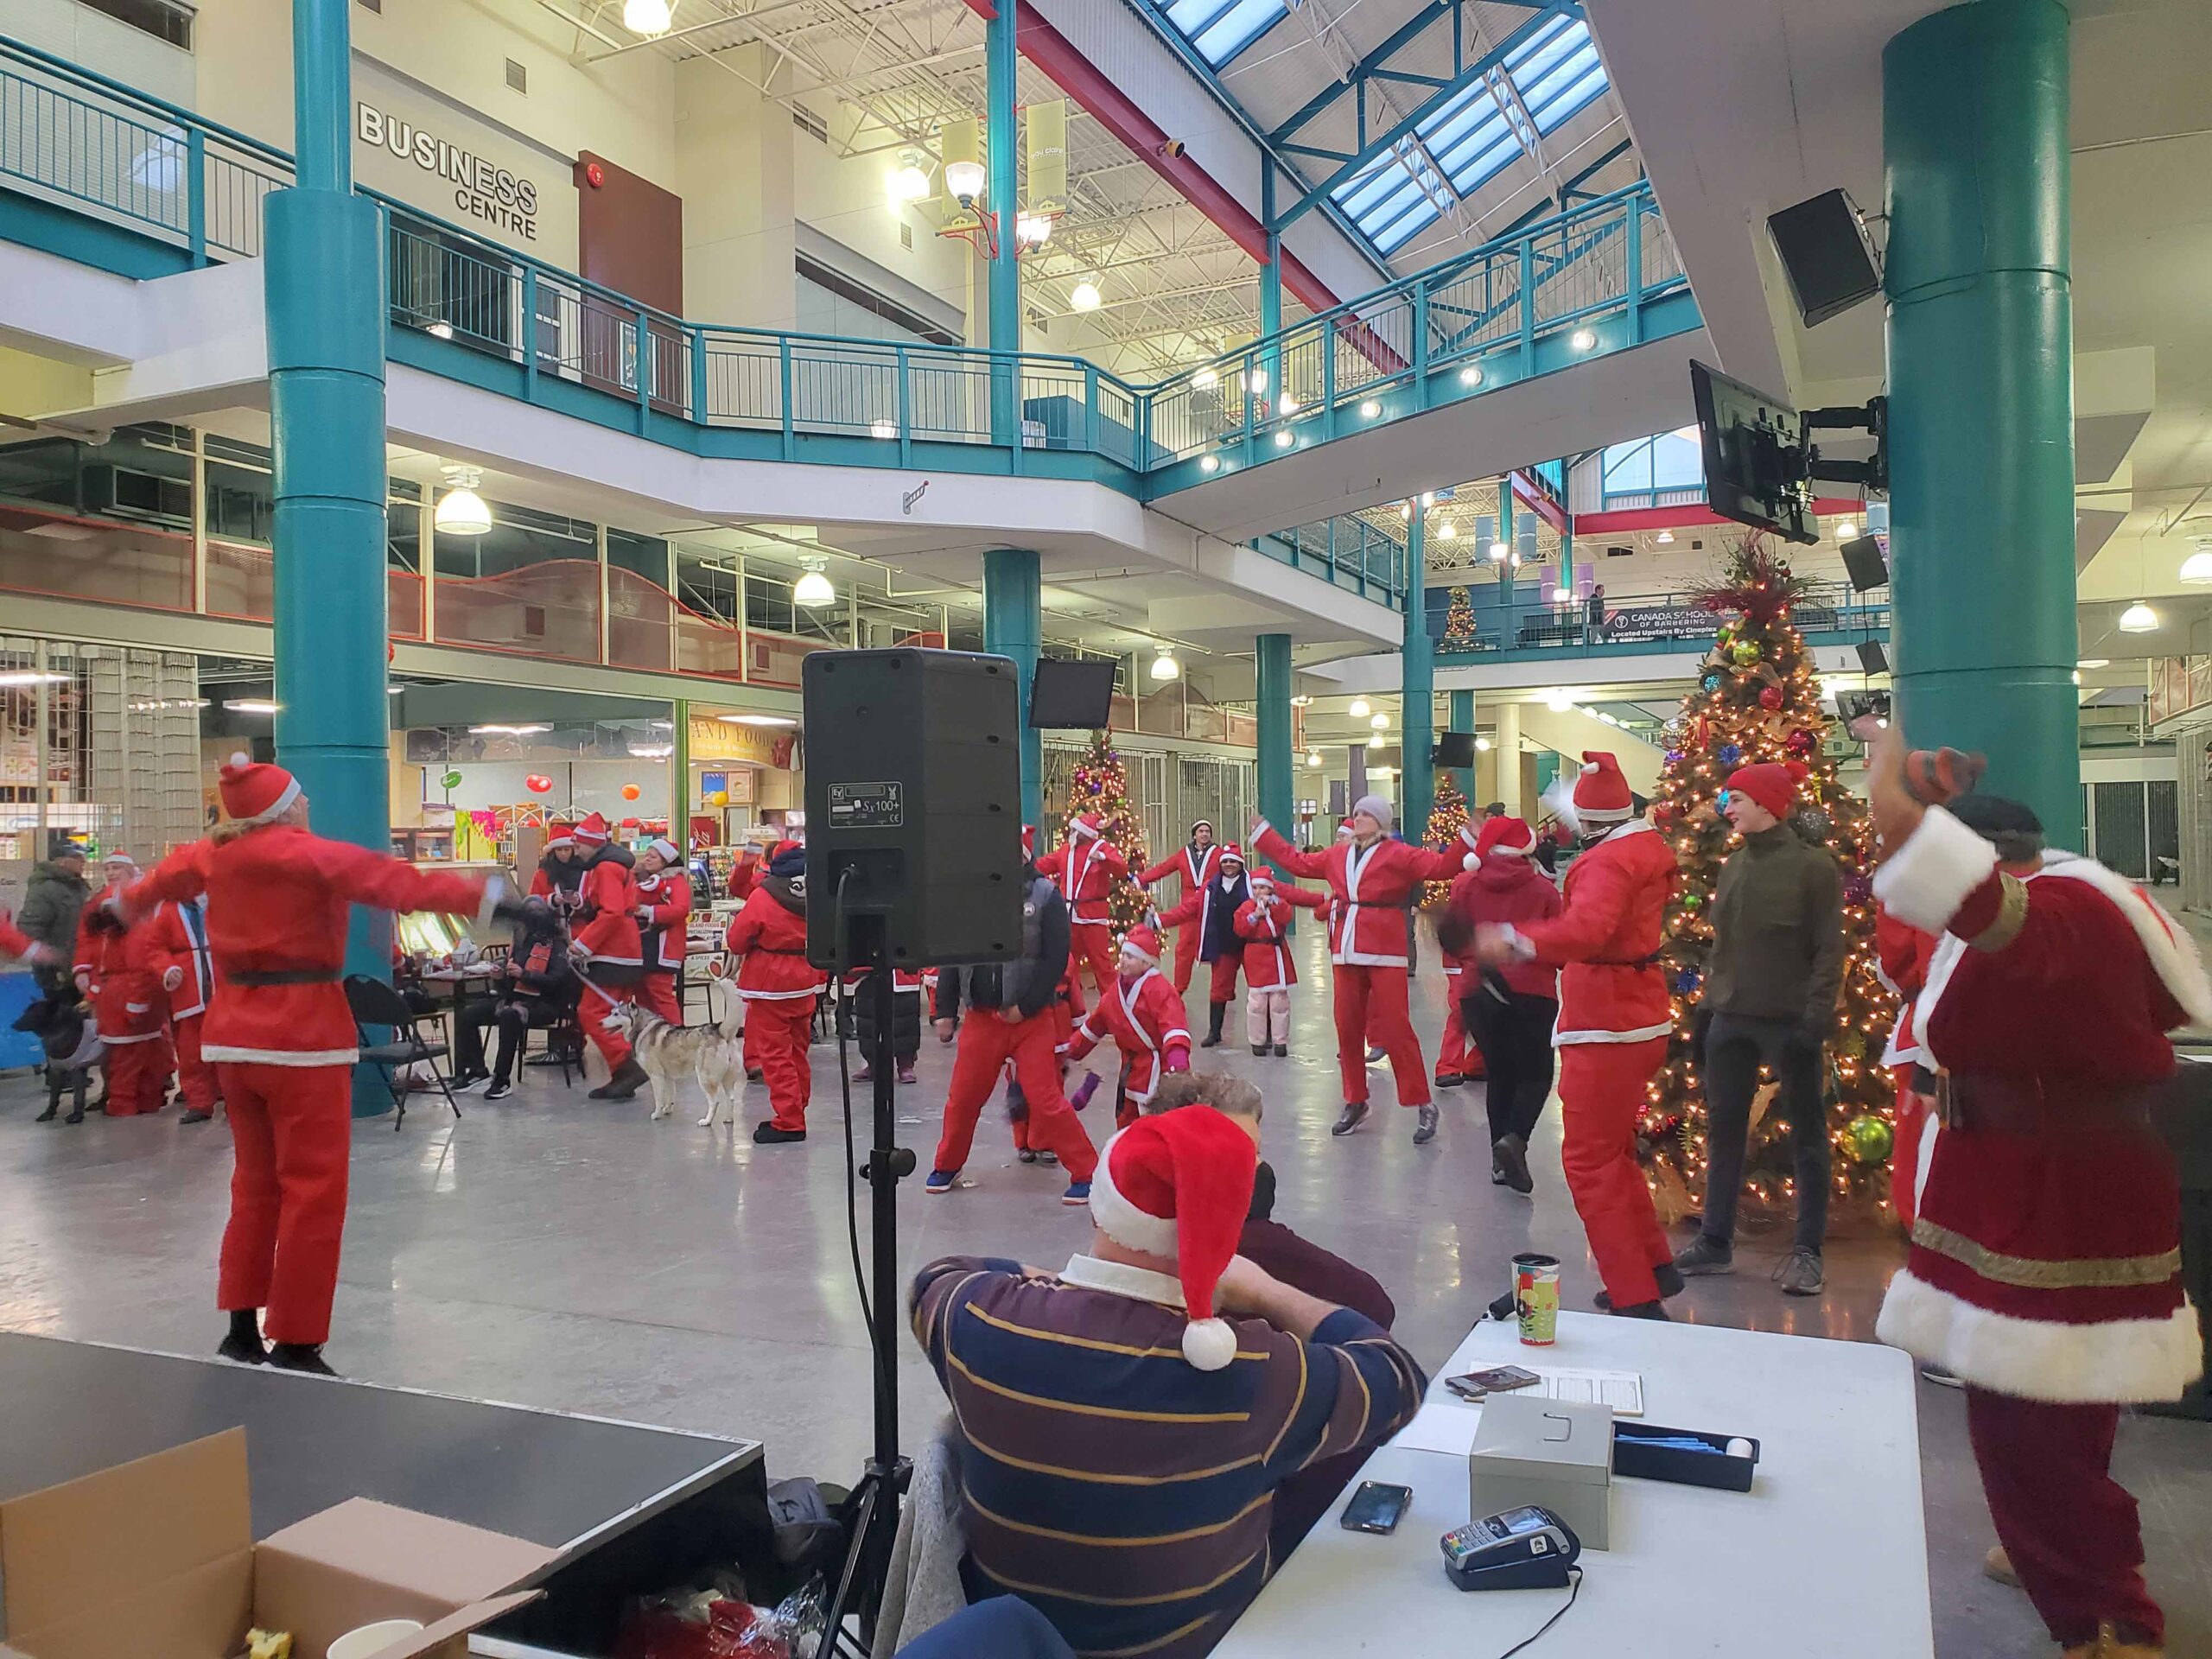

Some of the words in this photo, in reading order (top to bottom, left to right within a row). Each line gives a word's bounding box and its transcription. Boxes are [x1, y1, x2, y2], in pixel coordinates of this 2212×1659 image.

[358, 101, 537, 216] BUSINESS
[455, 189, 537, 240] CENTRE
[1631, 612, 1671, 621] CANADA
[1673, 610, 1714, 620] SCHOOL
[1655, 619, 1706, 627] BARBERING
[1645, 628, 1673, 637] Upstairs
